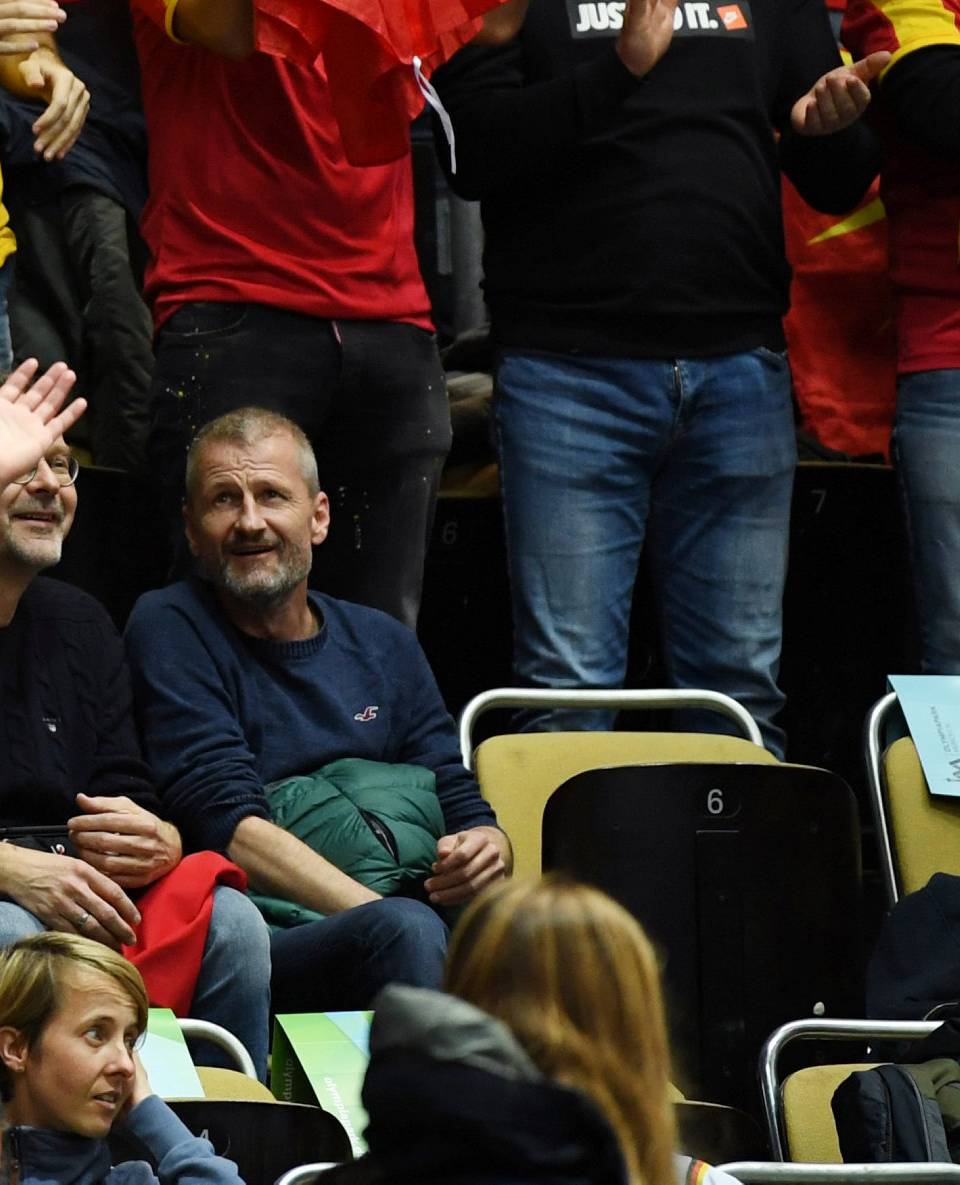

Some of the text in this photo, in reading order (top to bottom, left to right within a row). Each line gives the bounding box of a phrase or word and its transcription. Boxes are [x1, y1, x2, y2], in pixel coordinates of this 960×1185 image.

[576, 2, 627, 32] JUS
[684, 2, 719, 29] IT.
[810, 489, 826, 514] 7
[707, 788, 724, 814] 6
